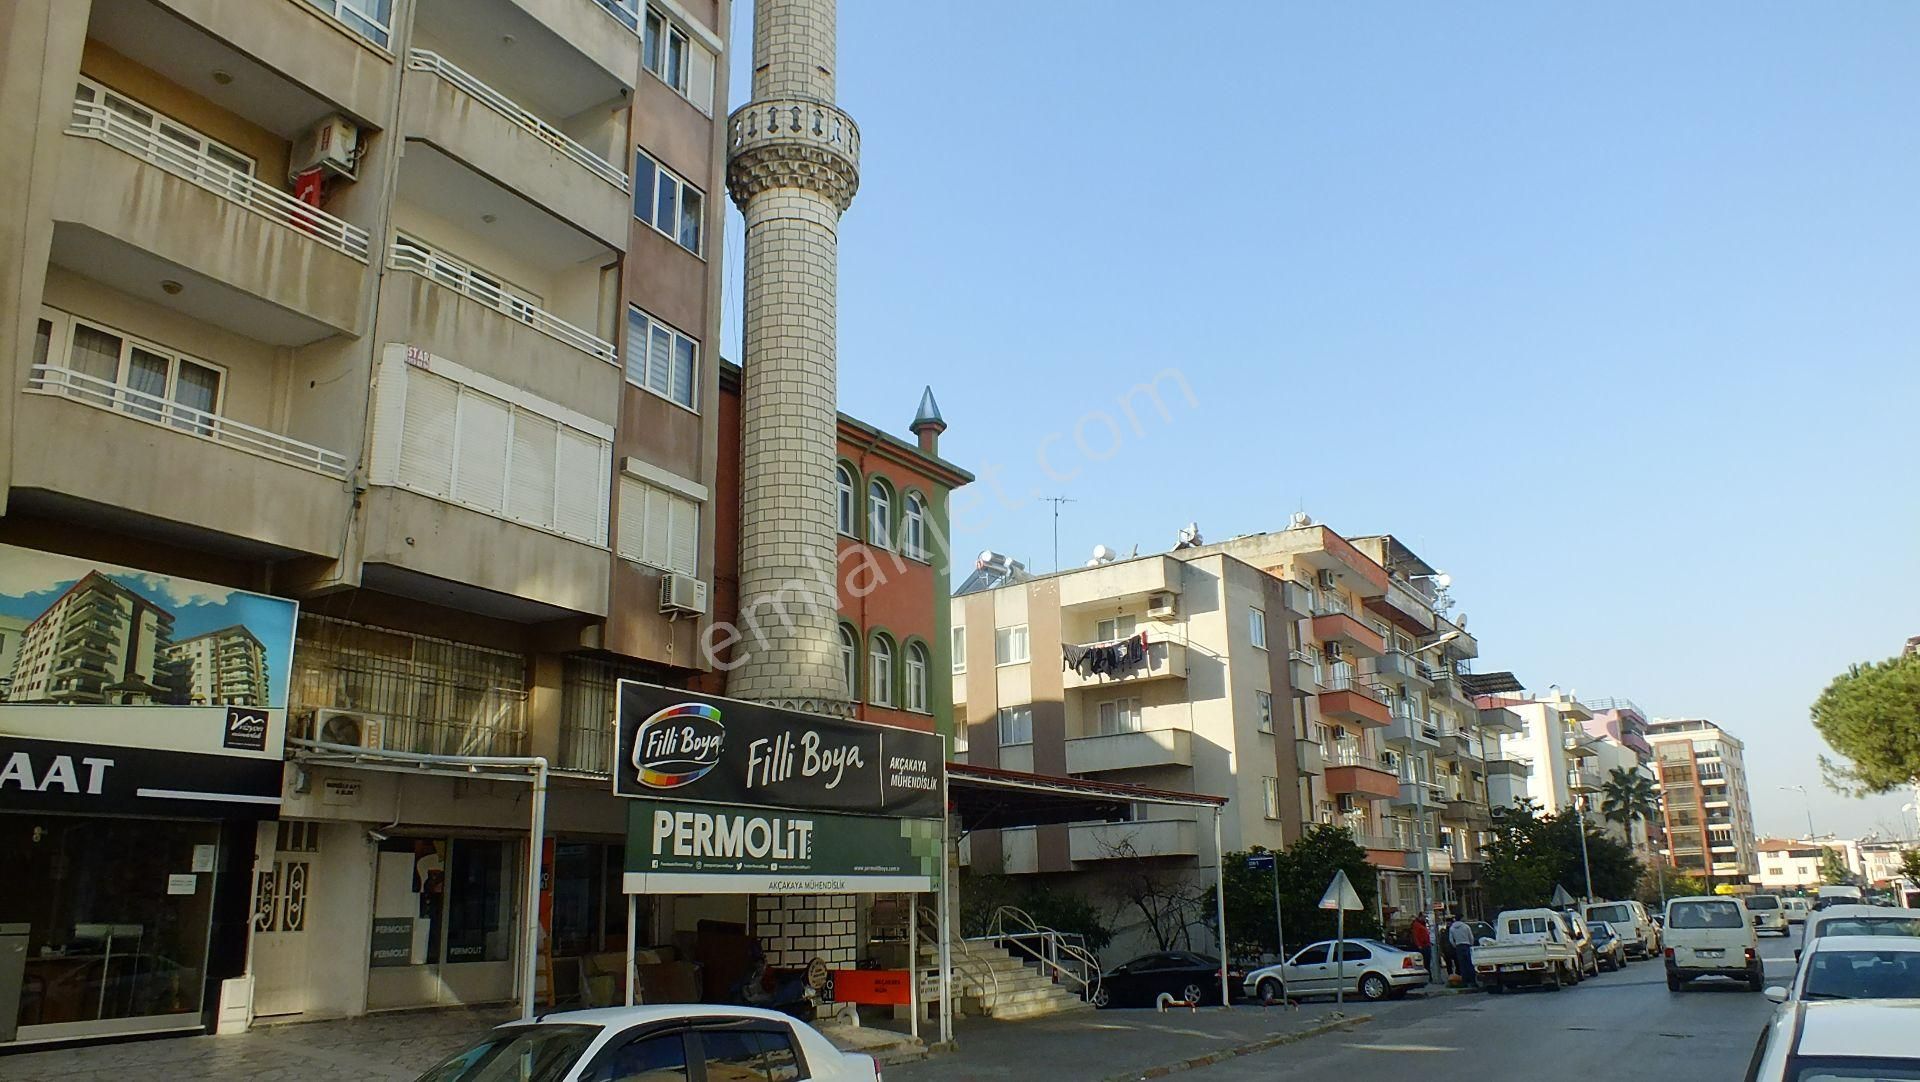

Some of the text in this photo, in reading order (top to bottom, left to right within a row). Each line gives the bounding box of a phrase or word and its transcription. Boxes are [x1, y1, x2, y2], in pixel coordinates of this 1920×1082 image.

[646, 726, 719, 760] Filli Boya
[746, 731, 864, 789] Filli Boya
[889, 757, 927, 775] AKÇAKAYA
[890, 774, 937, 790] MÜHENDİSLİK
[768, 879, 845, 892] AKÇAKAYA MÜHENDİSLİK
